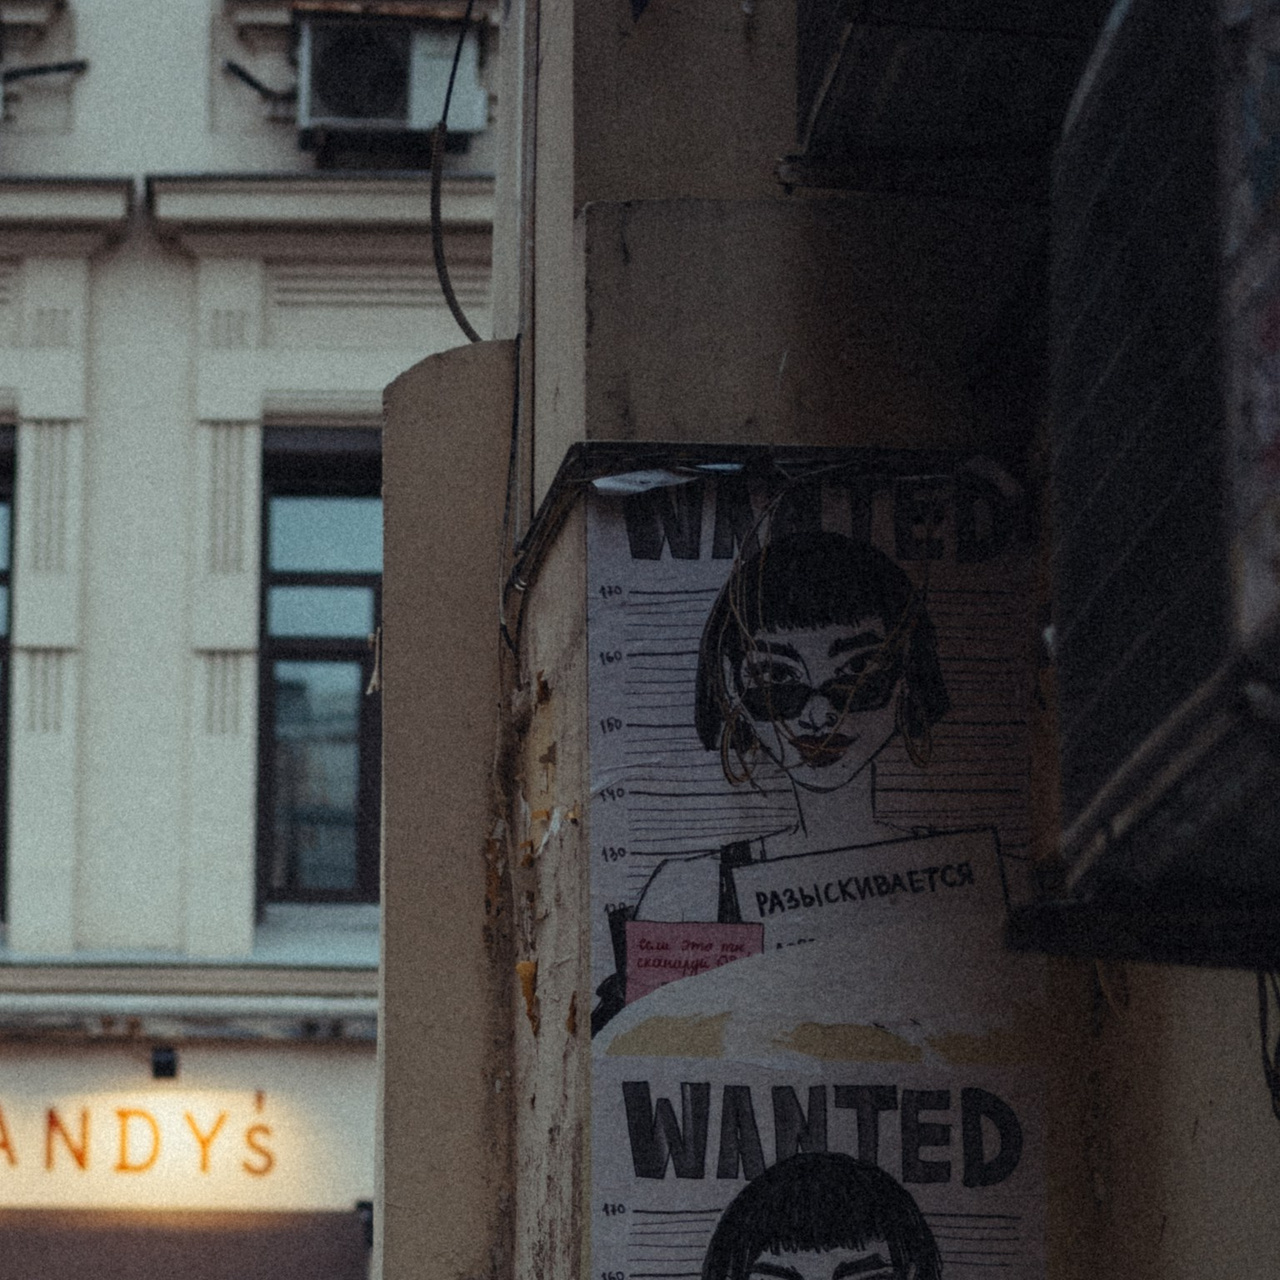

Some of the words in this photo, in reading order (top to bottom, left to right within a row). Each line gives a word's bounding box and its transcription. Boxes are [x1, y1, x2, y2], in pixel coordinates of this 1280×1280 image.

[599, 584, 623, 599] 170
[599, 651, 623, 666] 160
[600, 716, 623, 734] 150
[599, 787, 625, 801] 140
[601, 846, 627, 862] 130
[755, 862, 975, 918] РАЗЫСКИВАЕТСЯ
[622, 1081, 1022, 1188] WANTED
[602, 1203, 626, 1217] 170
